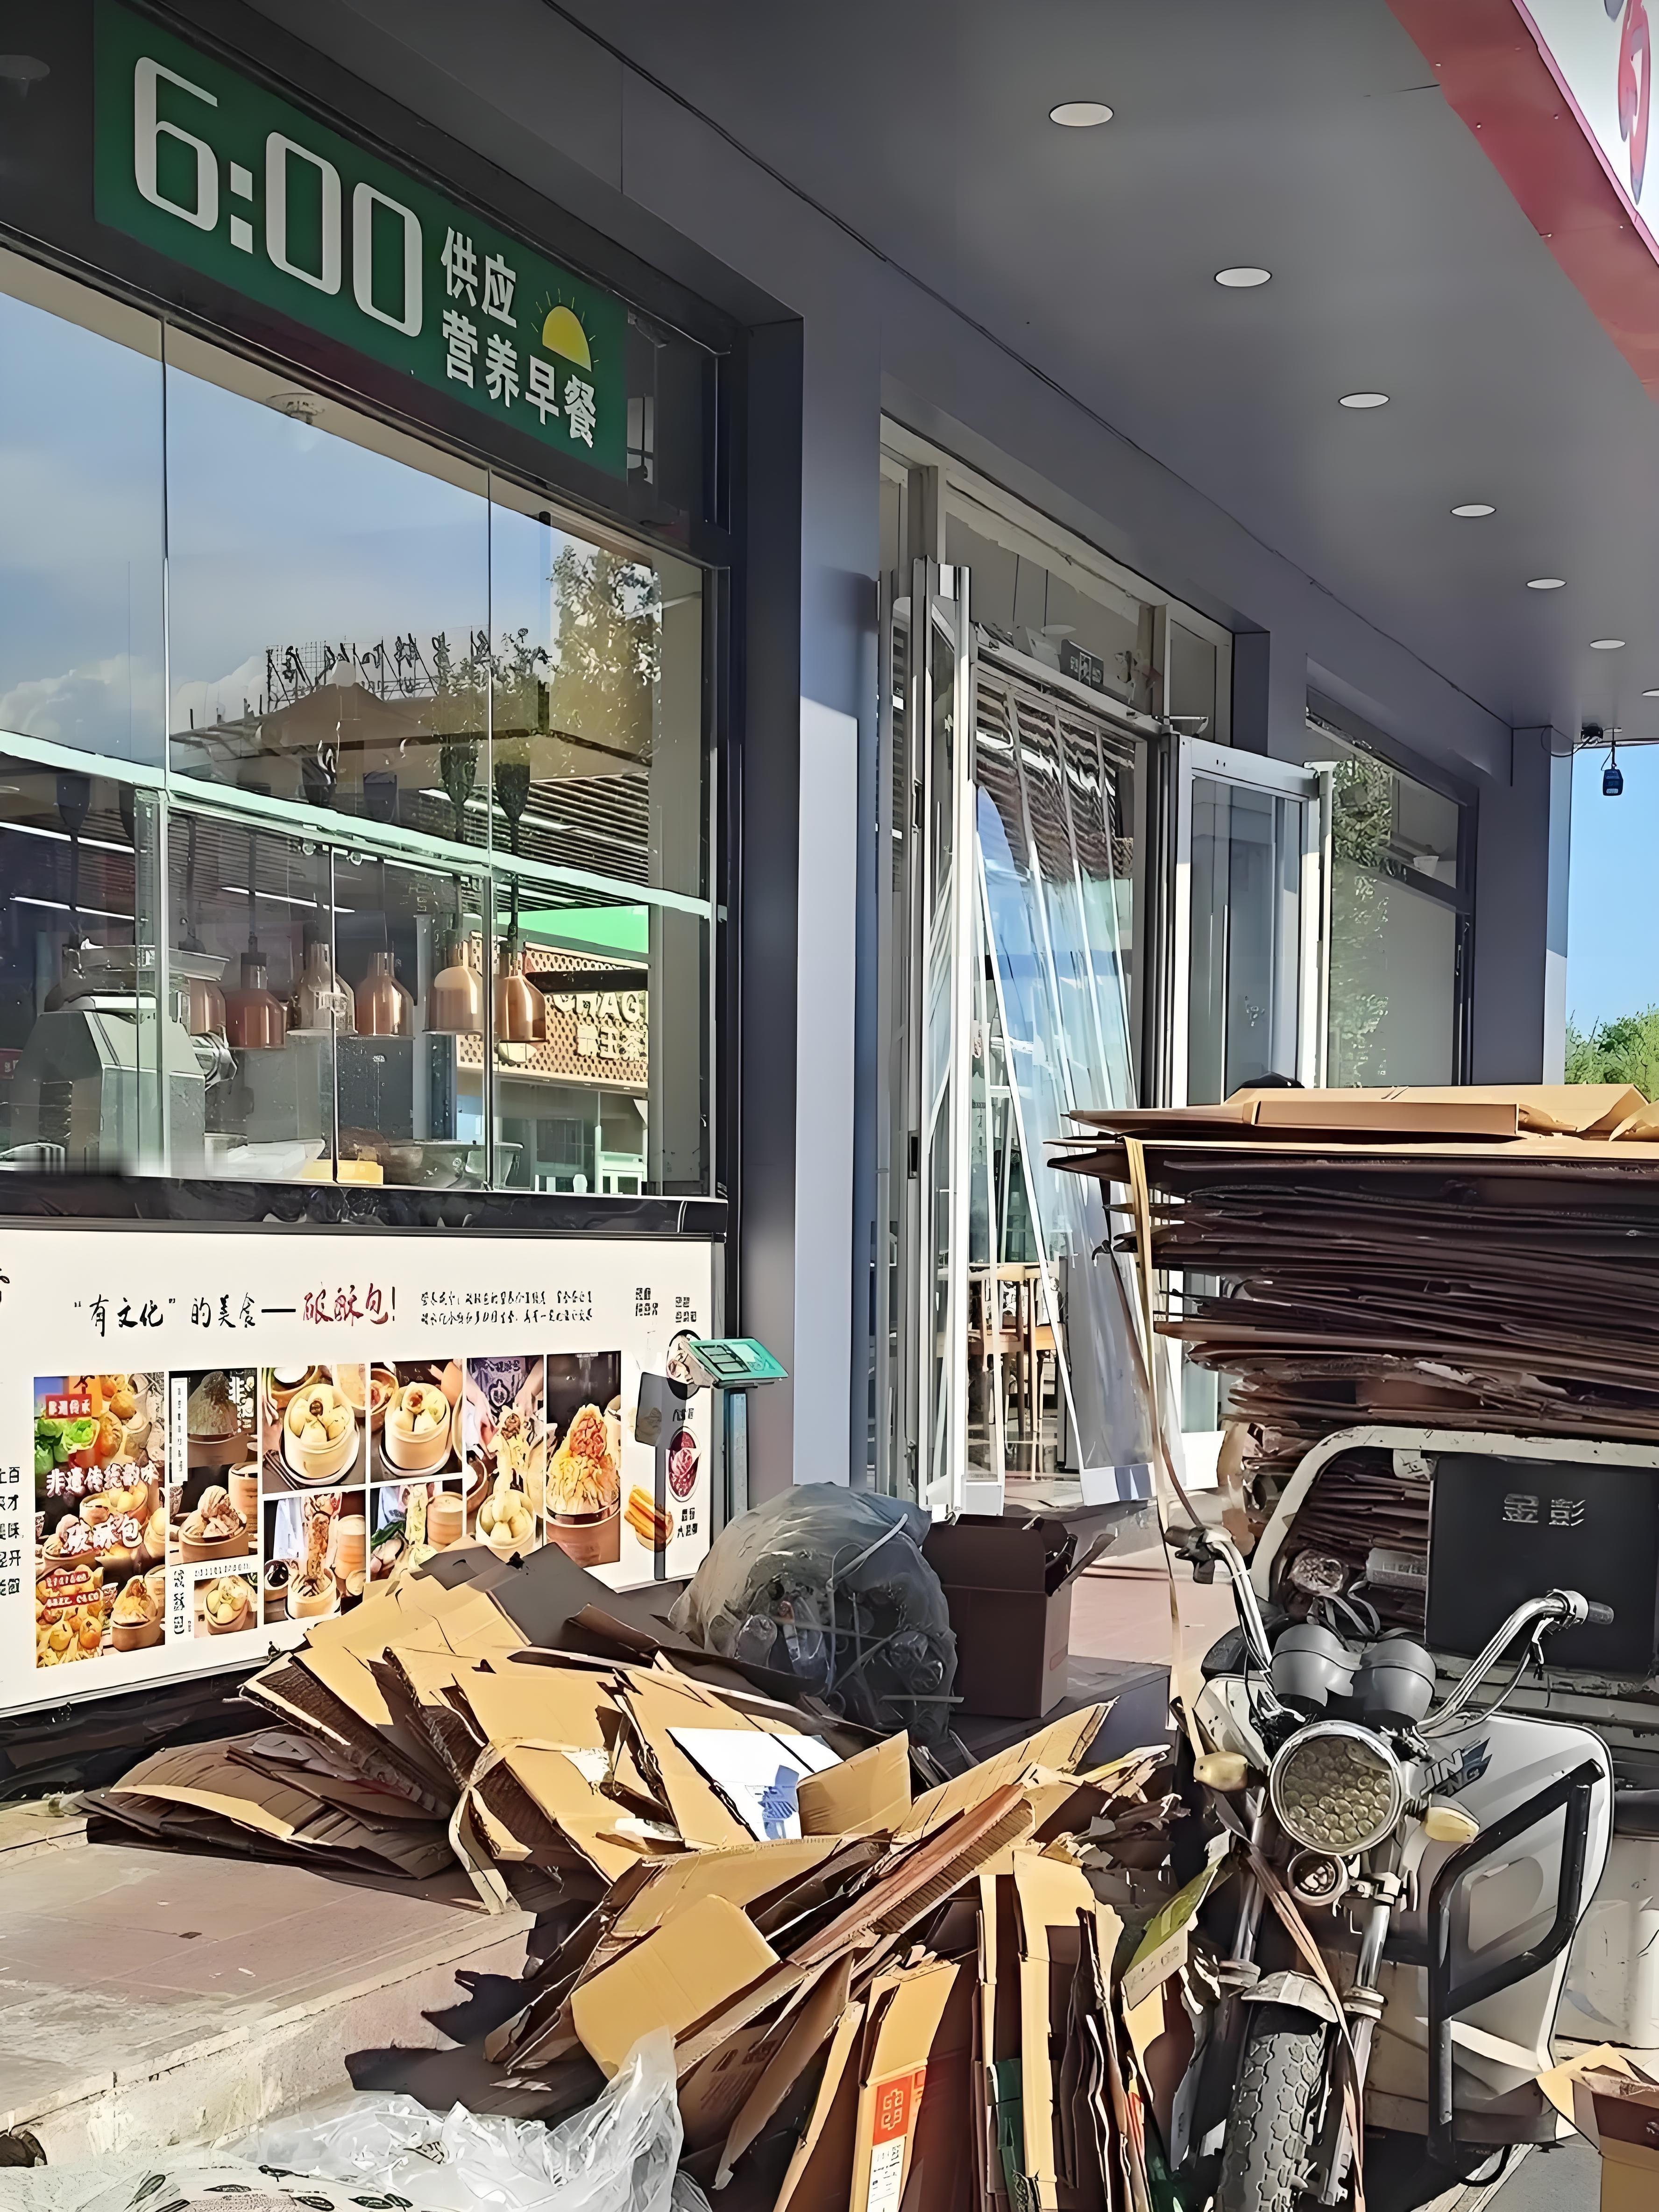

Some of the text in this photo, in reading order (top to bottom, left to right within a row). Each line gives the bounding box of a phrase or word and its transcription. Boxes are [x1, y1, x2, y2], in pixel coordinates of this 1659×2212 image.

[134, 57, 424, 338] 6:00
[441, 227, 518, 329] 供应
[441, 309, 598, 449] 营养早餐
[1419, 1748, 1464, 1796] JIN
